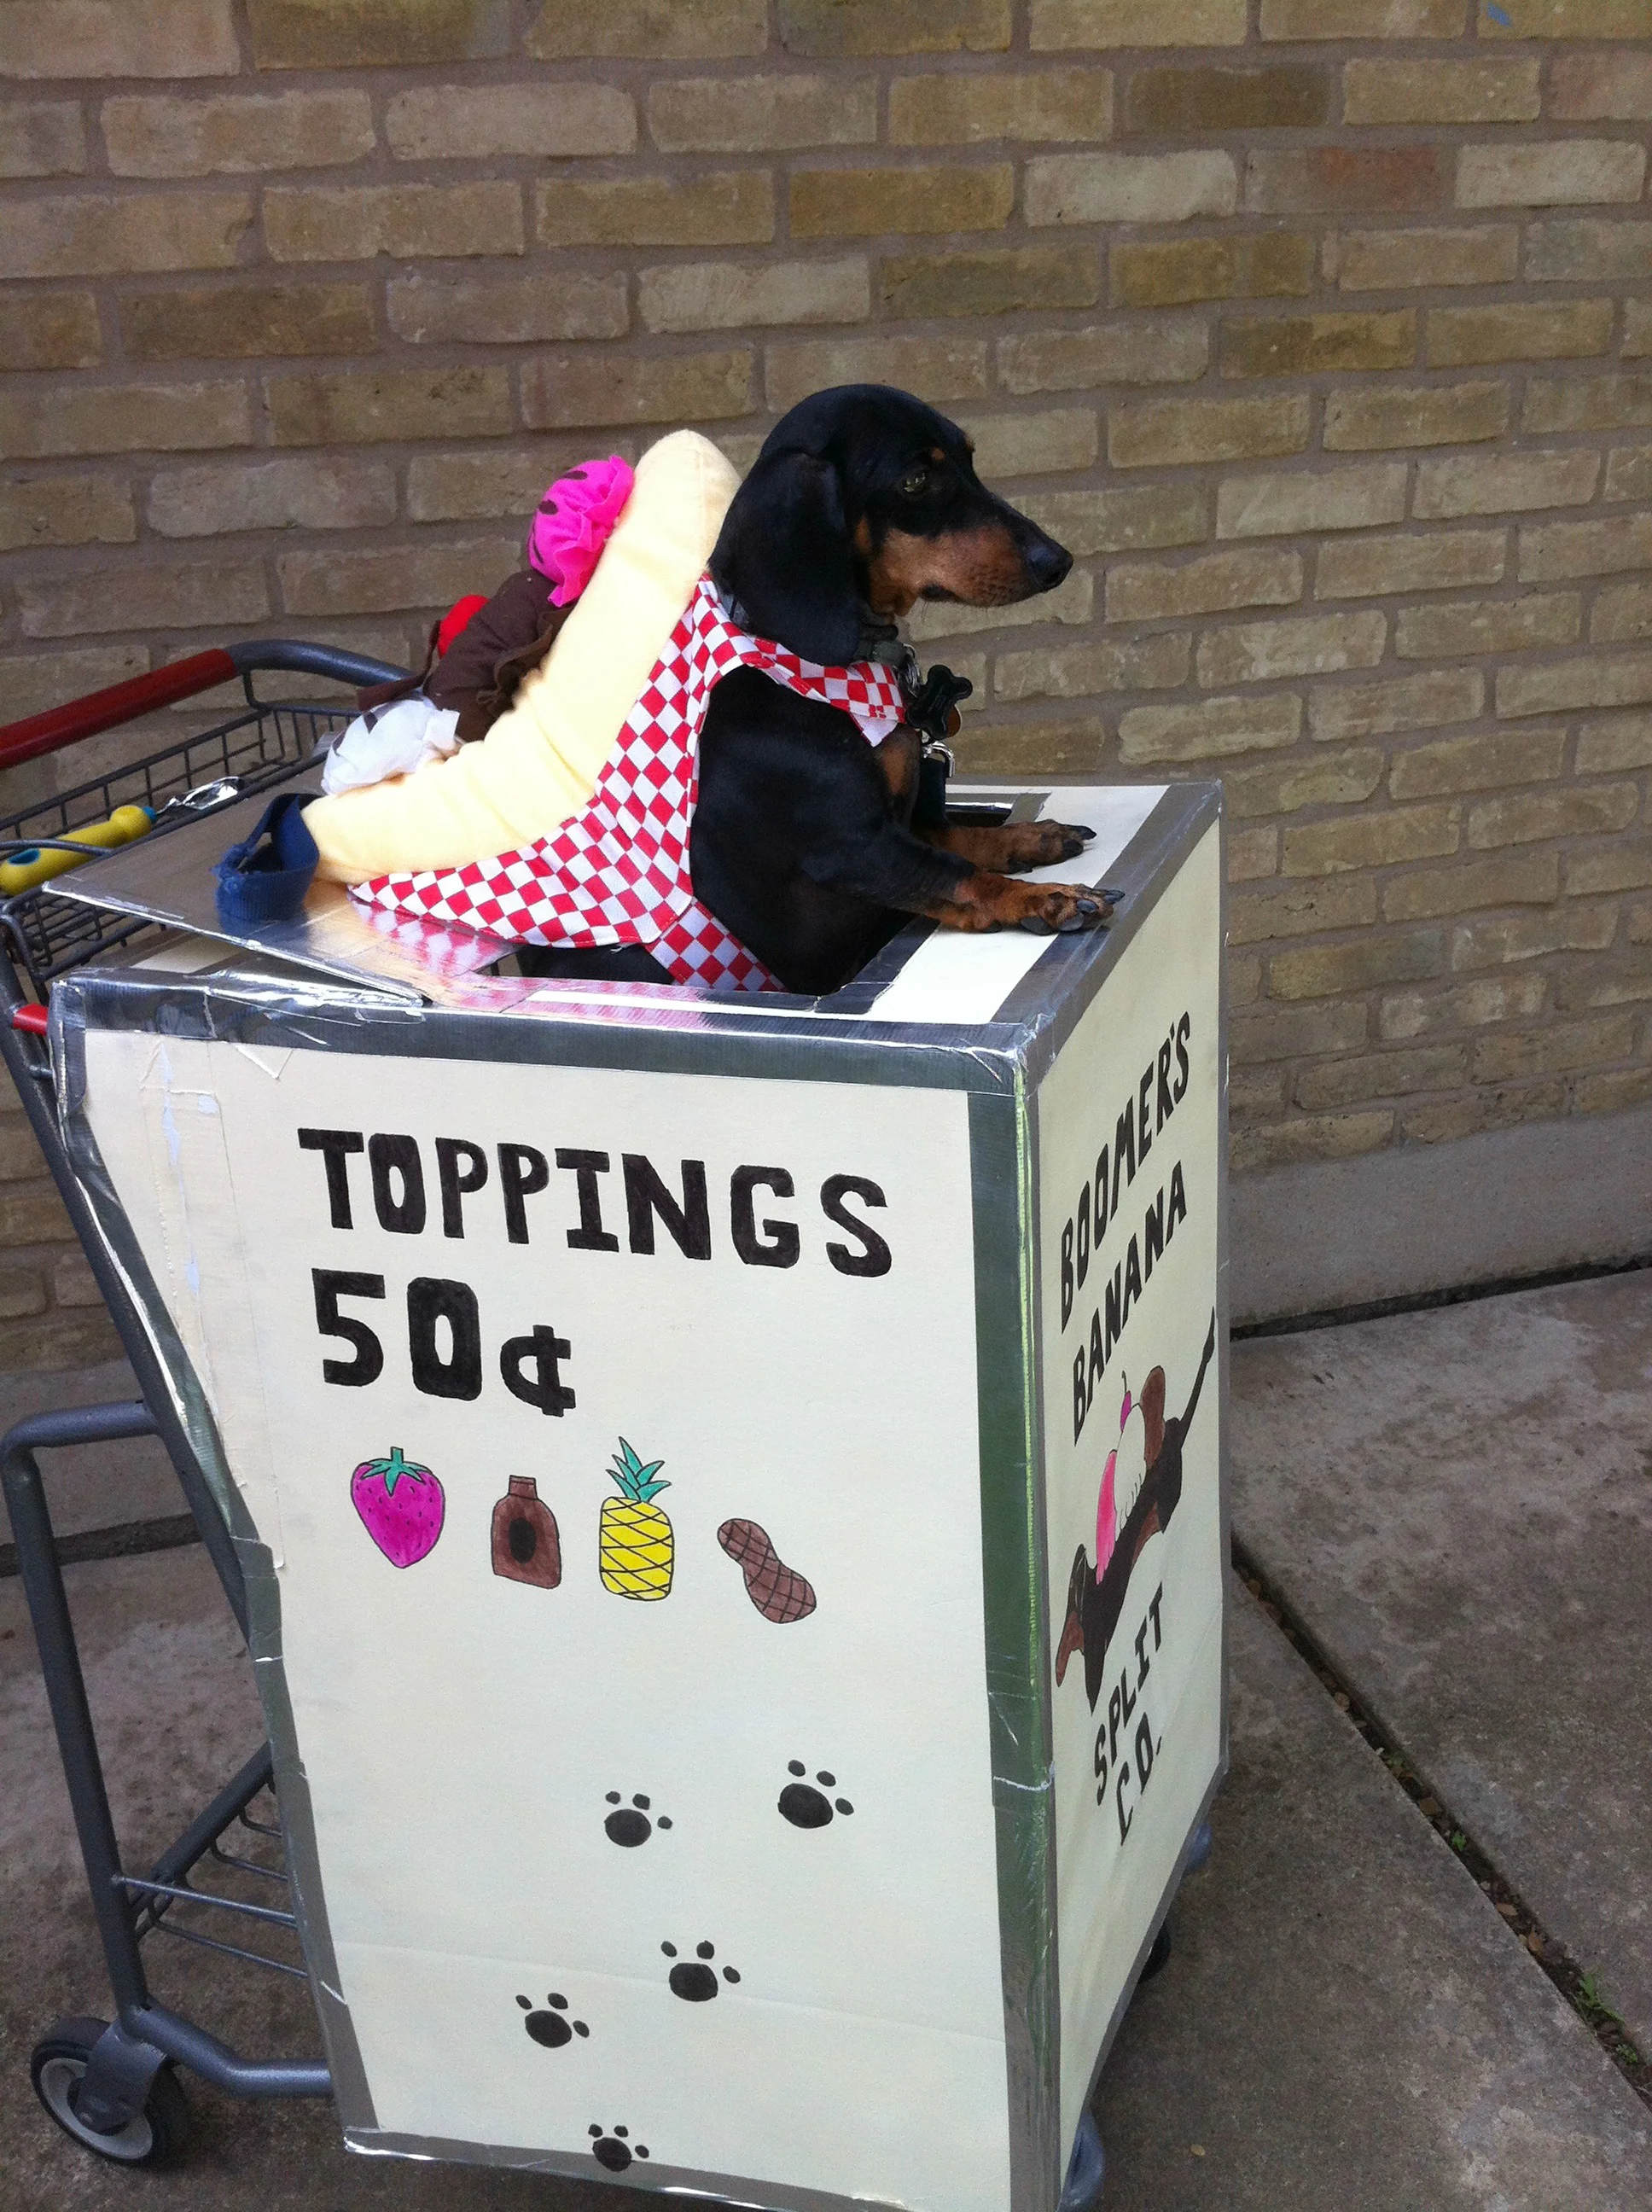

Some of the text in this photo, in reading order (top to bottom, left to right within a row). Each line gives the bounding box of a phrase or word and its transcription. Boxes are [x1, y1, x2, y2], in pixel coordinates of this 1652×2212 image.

[298, 1128, 892, 1278] TOPPINGS
[1062, 1011, 1190, 1335] BOOMER'S
[311, 1268, 576, 1417] 50¢
[1074, 1160, 1187, 1447] BANANA
[1094, 1581, 1162, 1806] SPLIT
[1116, 1712, 1161, 1846] CO.
